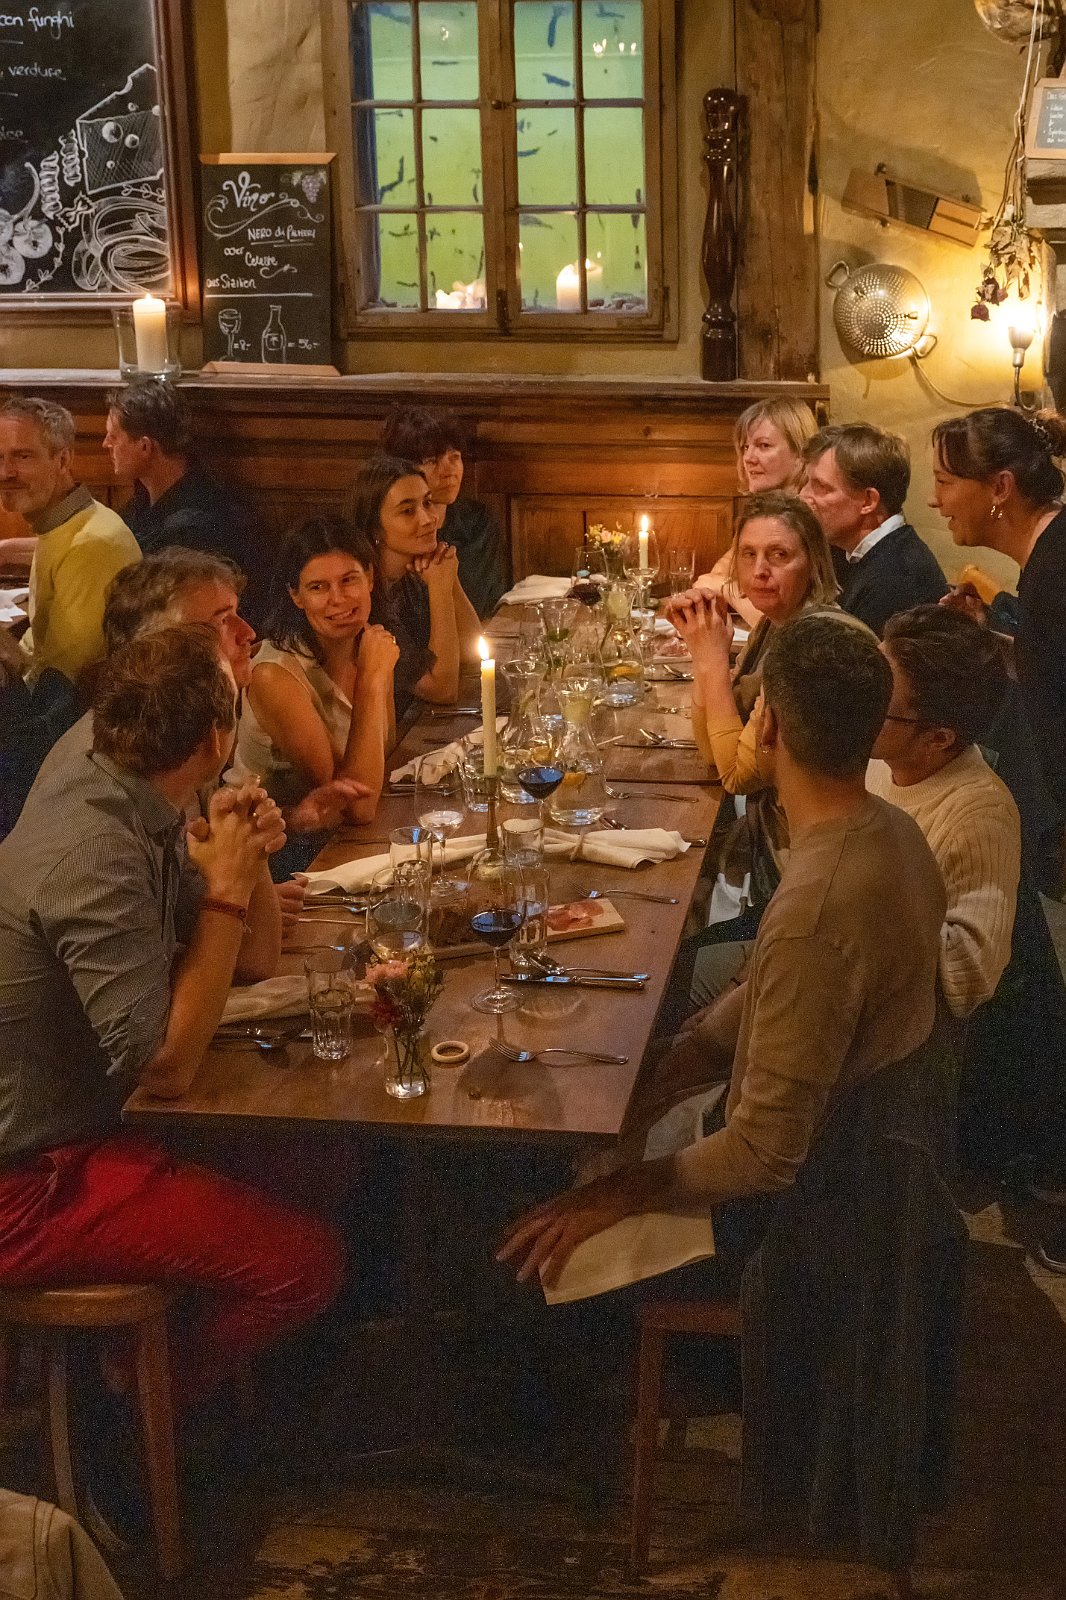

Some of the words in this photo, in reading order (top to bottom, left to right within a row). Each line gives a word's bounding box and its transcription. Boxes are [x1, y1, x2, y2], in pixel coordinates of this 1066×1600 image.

[28, 6, 75, 40] funghi
[8, 62, 66, 81] verdure
[222, 171, 276, 212] Vino
[247, 228, 272, 240] NERO
[223, 246, 245, 256] oder
[206, 278, 220, 288] aus
[220, 273, 257, 289] Sizilien
